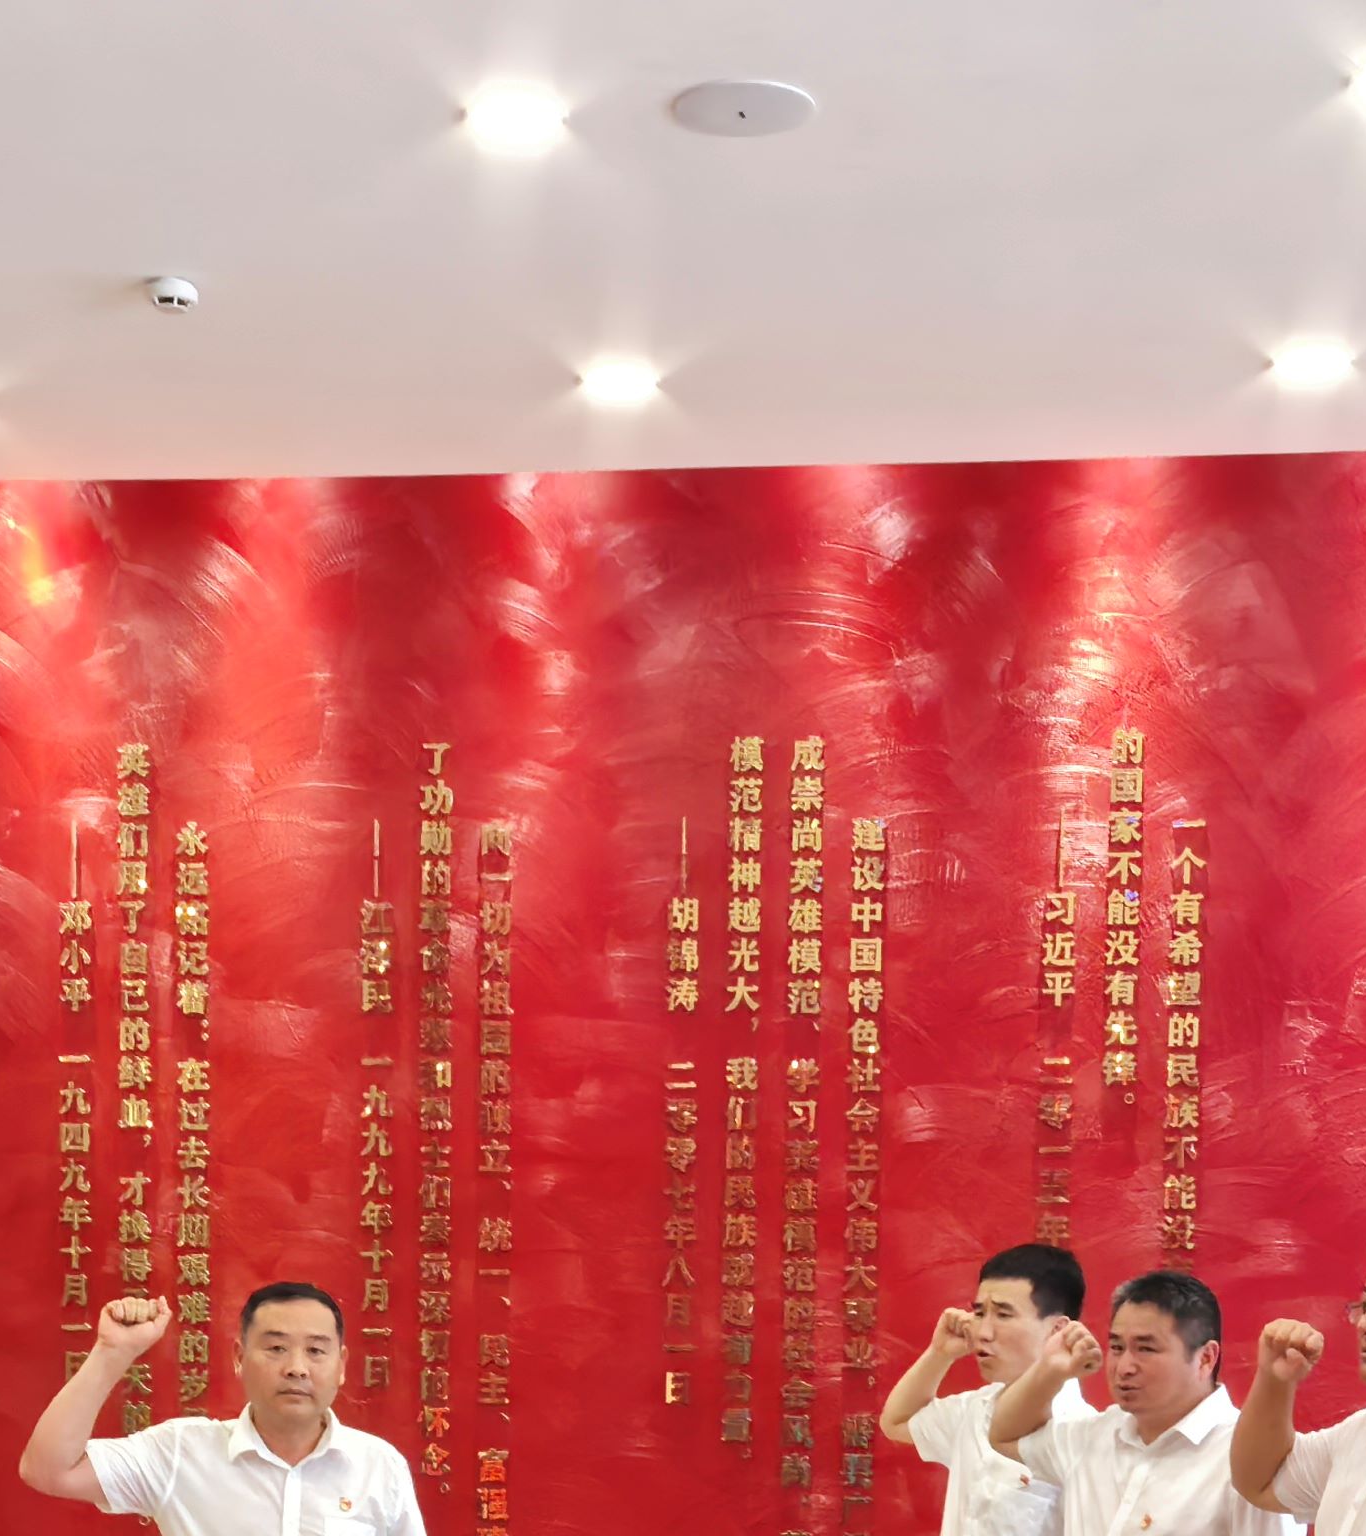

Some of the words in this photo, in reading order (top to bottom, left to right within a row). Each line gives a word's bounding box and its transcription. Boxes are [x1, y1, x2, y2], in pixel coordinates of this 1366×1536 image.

[1101, 727, 1146, 1105] 的国家不能没有先锋。
[359, 1055, 394, 1388] 一九九九年十月一日
